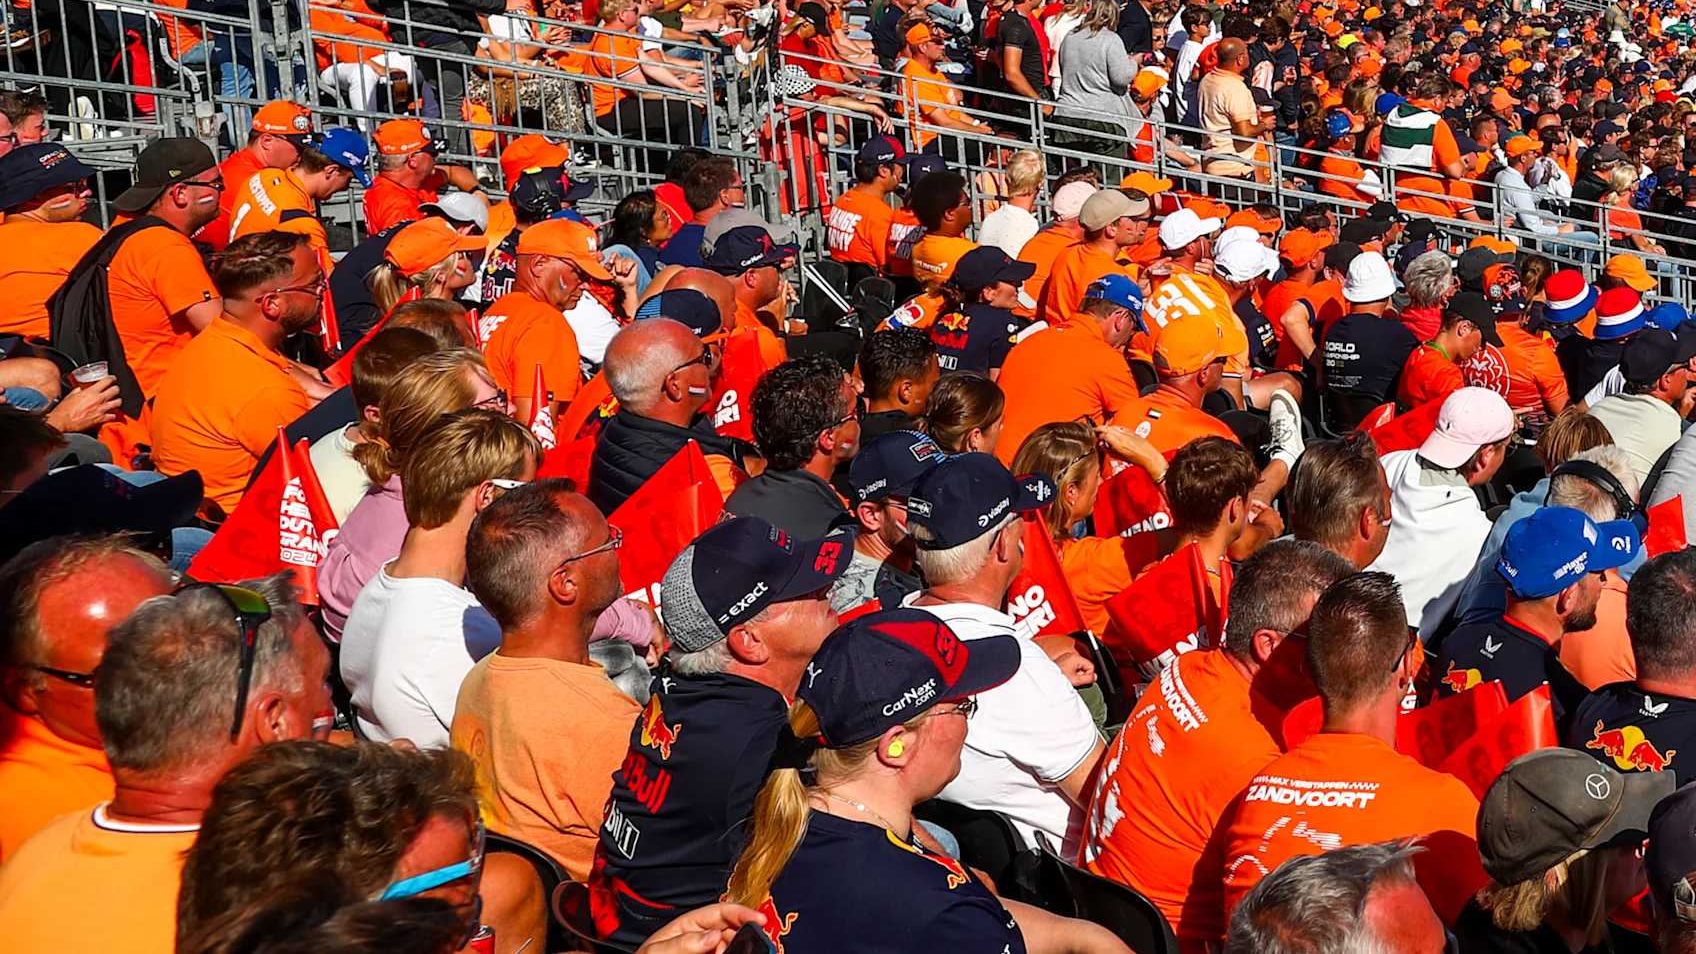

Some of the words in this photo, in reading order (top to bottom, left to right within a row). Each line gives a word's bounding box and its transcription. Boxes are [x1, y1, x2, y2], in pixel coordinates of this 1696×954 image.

[892, 242, 916, 259] ARM
[988, 497, 1010, 520] viaplay
[814, 541, 843, 575] 33
[1563, 551, 1588, 573] Player
[728, 581, 769, 616] exact
[1007, 585, 1044, 618] NO
[882, 677, 937, 717] CarNext
[915, 688, 937, 708] .com
[628, 758, 673, 814] Bull
[1269, 776, 1289, 786] MAX
[1290, 779, 1349, 790] VERSTAPPEN
[1245, 784, 1376, 809] ZANDVOORT
